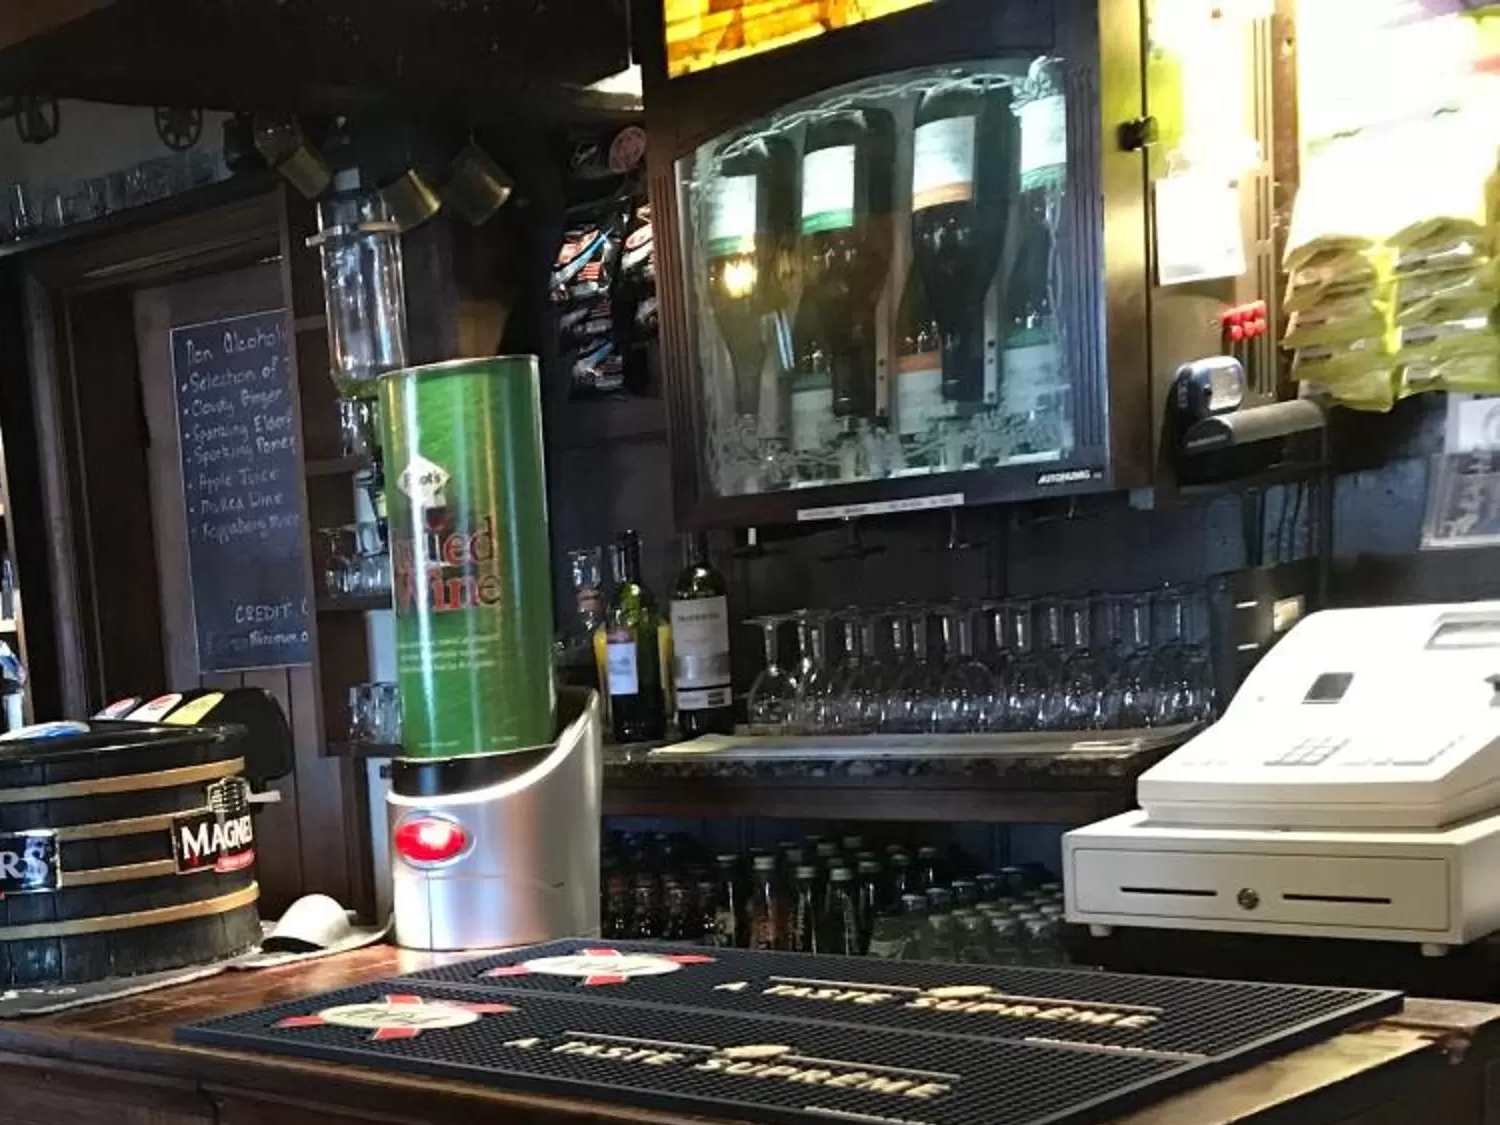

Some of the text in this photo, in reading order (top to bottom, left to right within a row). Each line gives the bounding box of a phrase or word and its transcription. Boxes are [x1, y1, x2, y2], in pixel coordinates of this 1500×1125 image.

[181, 815, 253, 860] MAGNE
[905, 997, 1157, 1028] SUPREME
[552, 1041, 684, 1065] TASTE
[695, 1058, 950, 1098] SUPREME
